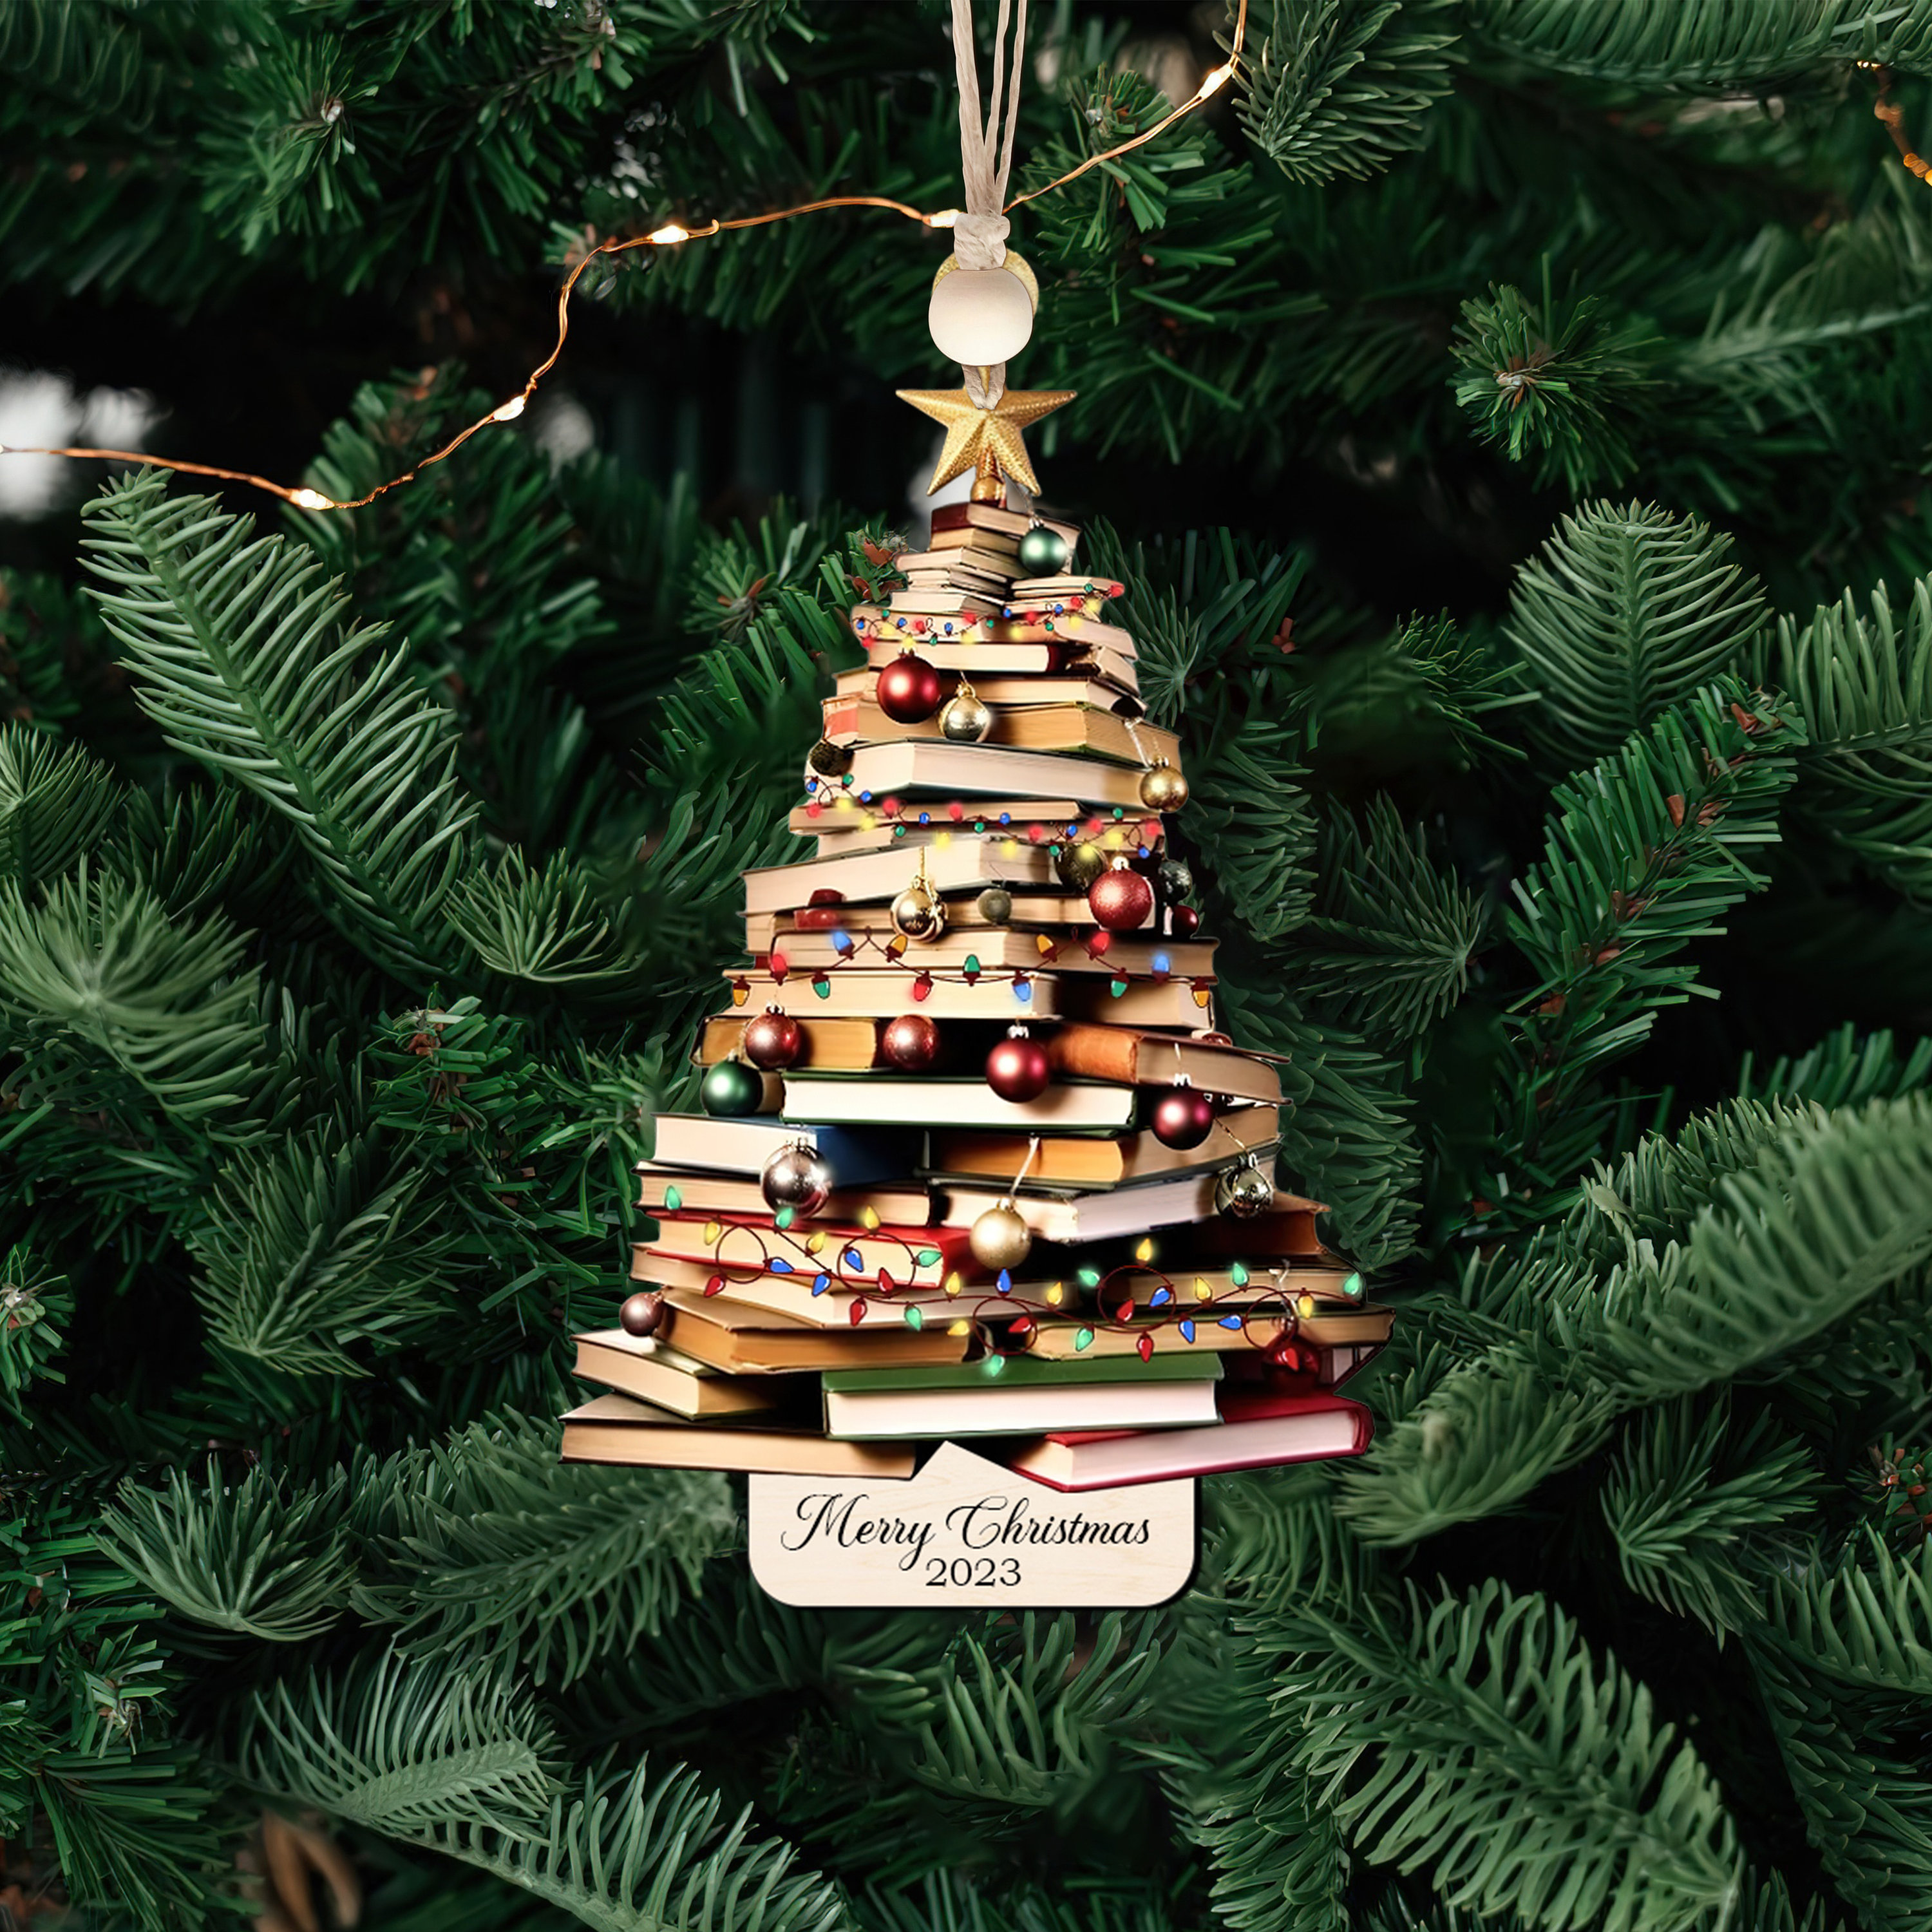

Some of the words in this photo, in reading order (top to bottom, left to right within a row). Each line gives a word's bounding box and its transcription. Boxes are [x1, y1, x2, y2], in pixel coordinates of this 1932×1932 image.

[781, 1493, 936, 1571] Merry
[945, 1496, 1150, 1549] Christmas
[925, 1558, 1021, 1587] 2023
